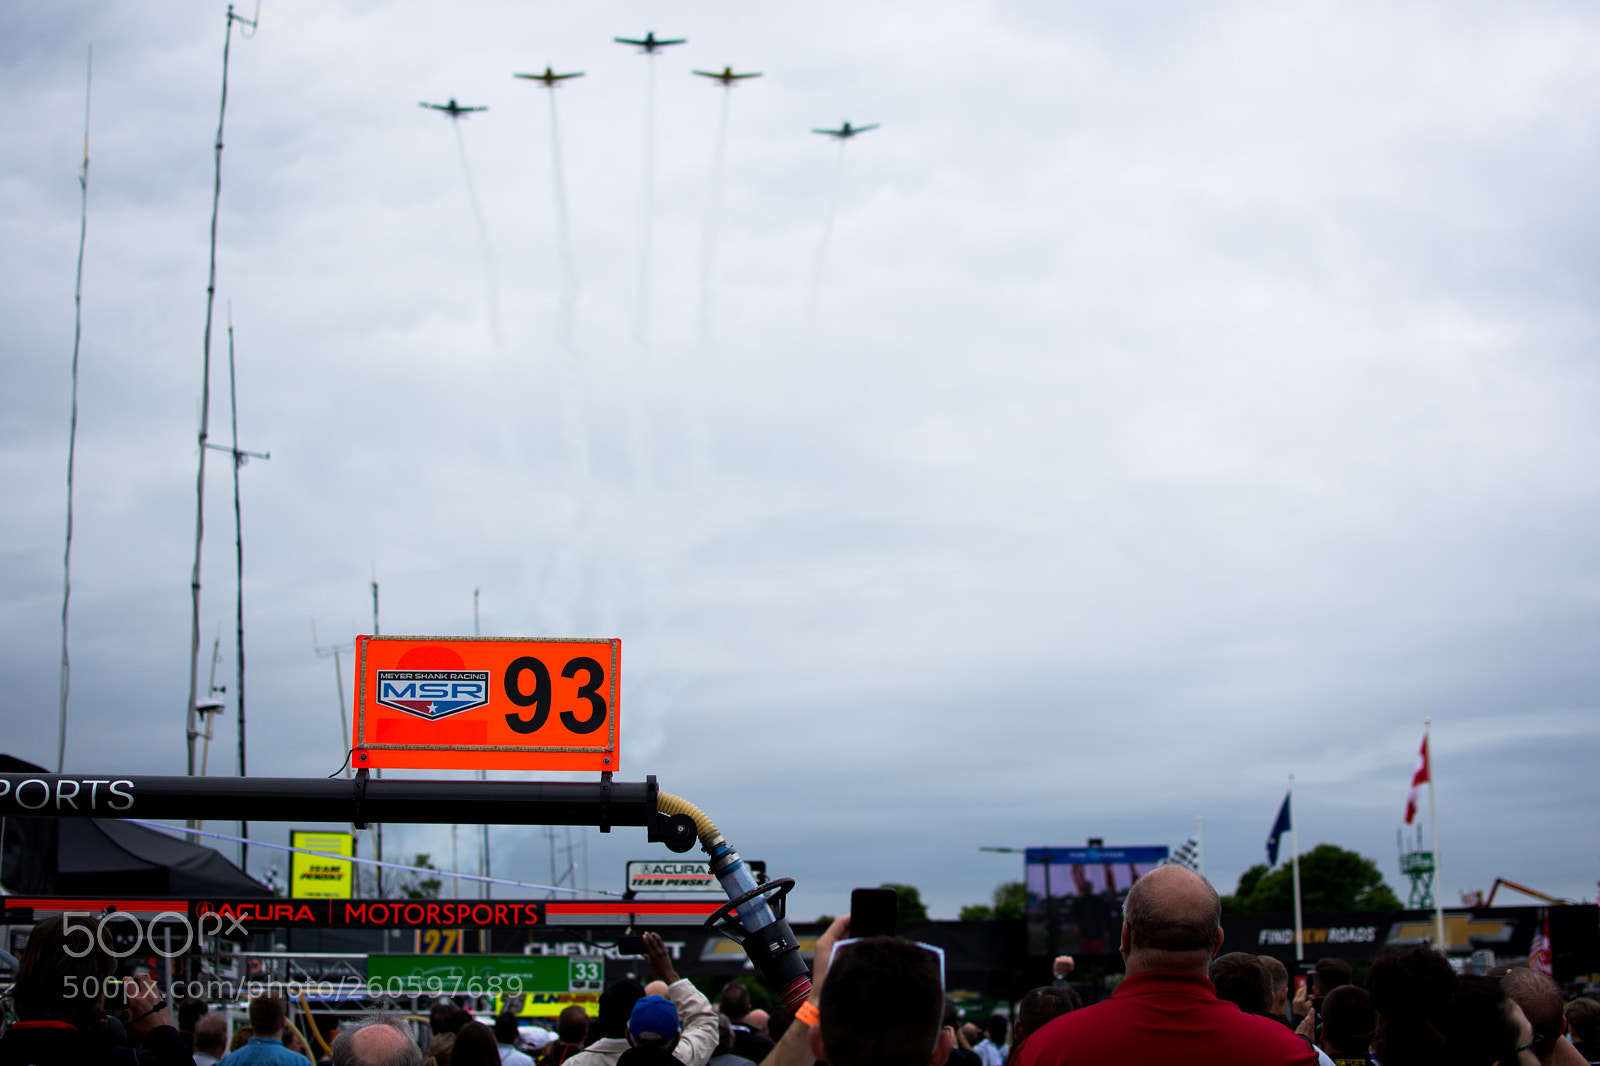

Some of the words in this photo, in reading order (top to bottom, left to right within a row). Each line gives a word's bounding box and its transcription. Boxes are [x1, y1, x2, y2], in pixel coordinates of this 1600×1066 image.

[383, 682, 483, 699] MSR
[503, 655, 607, 735] 93
[652, 864, 706, 875] ACURA
[631, 878, 665, 887] TEAM
[665, 878, 712, 887] PENSKE
[217, 902, 316, 922] ACURA
[345, 903, 538, 925] MOTORSPORTS
[423, 929, 459, 954] 27
[1258, 928, 1295, 946] FIND
[1327, 925, 1377, 944] ROADS
[523, 941, 687, 961] CHEVRT
[574, 963, 599, 980] 33
